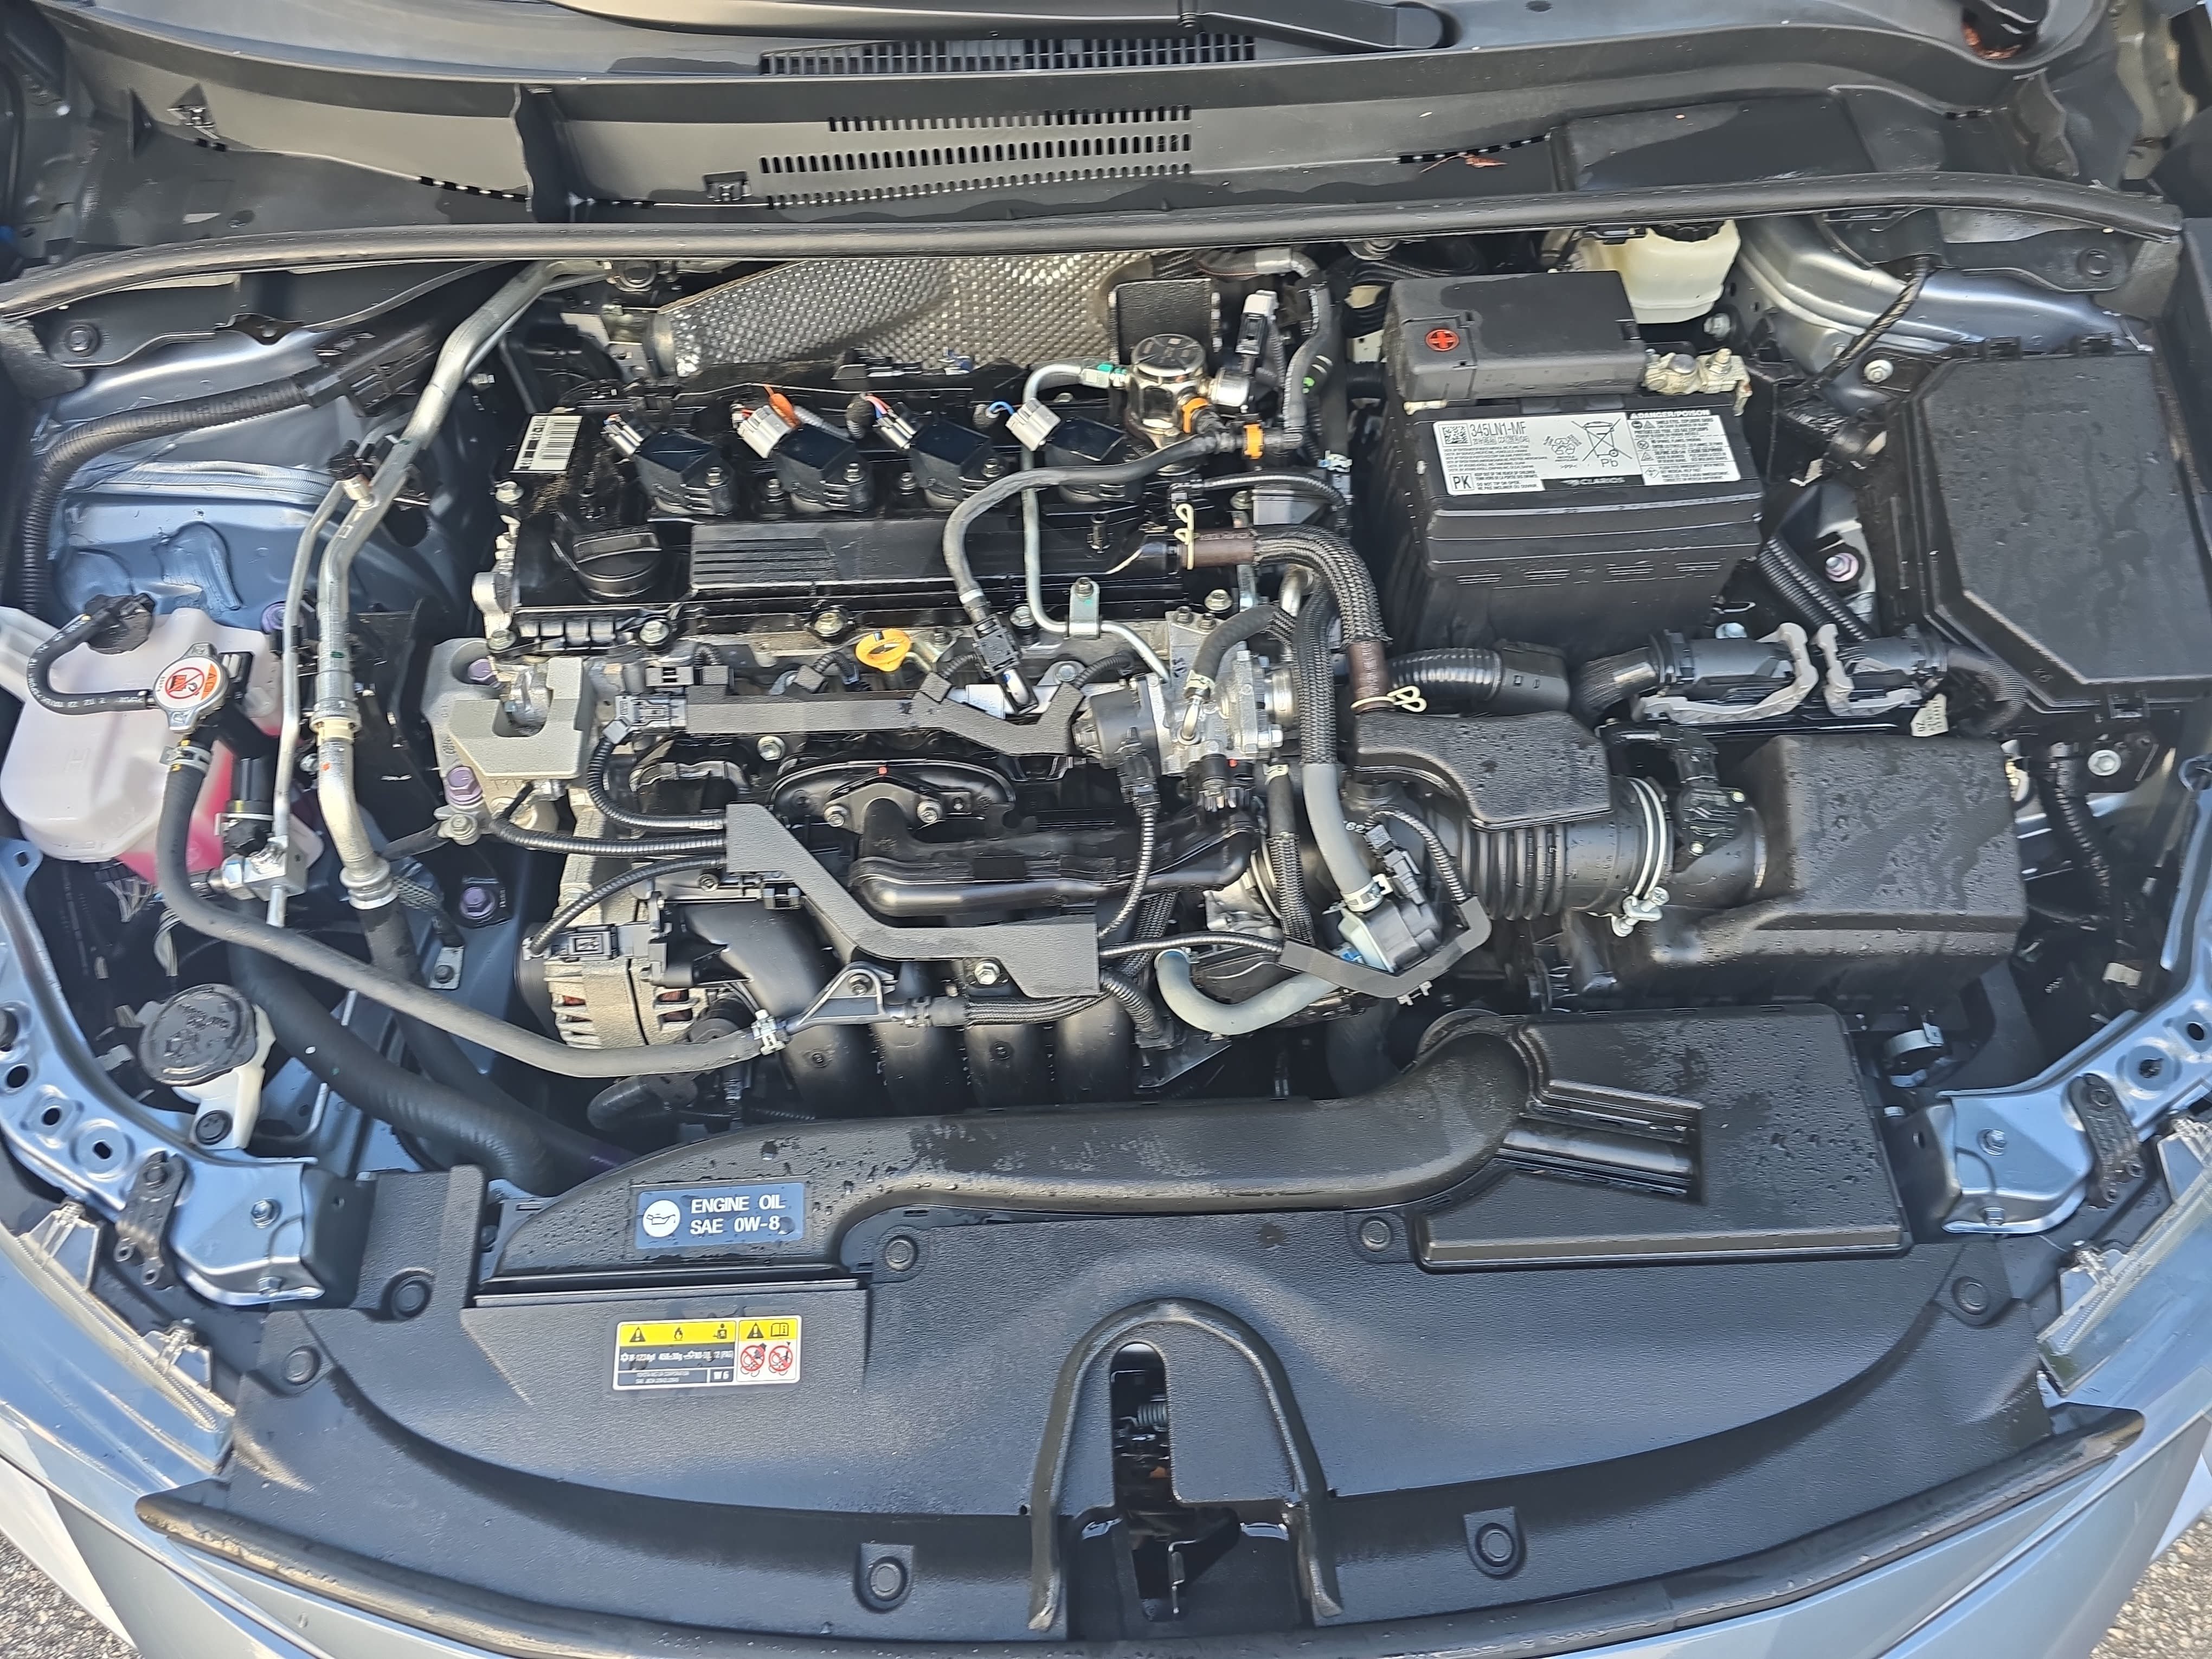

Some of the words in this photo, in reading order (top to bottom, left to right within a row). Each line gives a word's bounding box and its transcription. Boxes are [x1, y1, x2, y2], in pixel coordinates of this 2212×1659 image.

[1638, 409, 1711, 419] DANGER/POISON
[1470, 421, 1526, 436] 345LN1-MF
[1600, 458, 1618, 467] Pb
[1453, 475, 1471, 489] PK
[1580, 477, 1626, 485] CLARIOS
[691, 1195, 751, 1213] ENGINE
[759, 1194, 786, 1210] OIL
[690, 1218, 724, 1235] SAE
[734, 1215, 781, 1232] 0W-8
